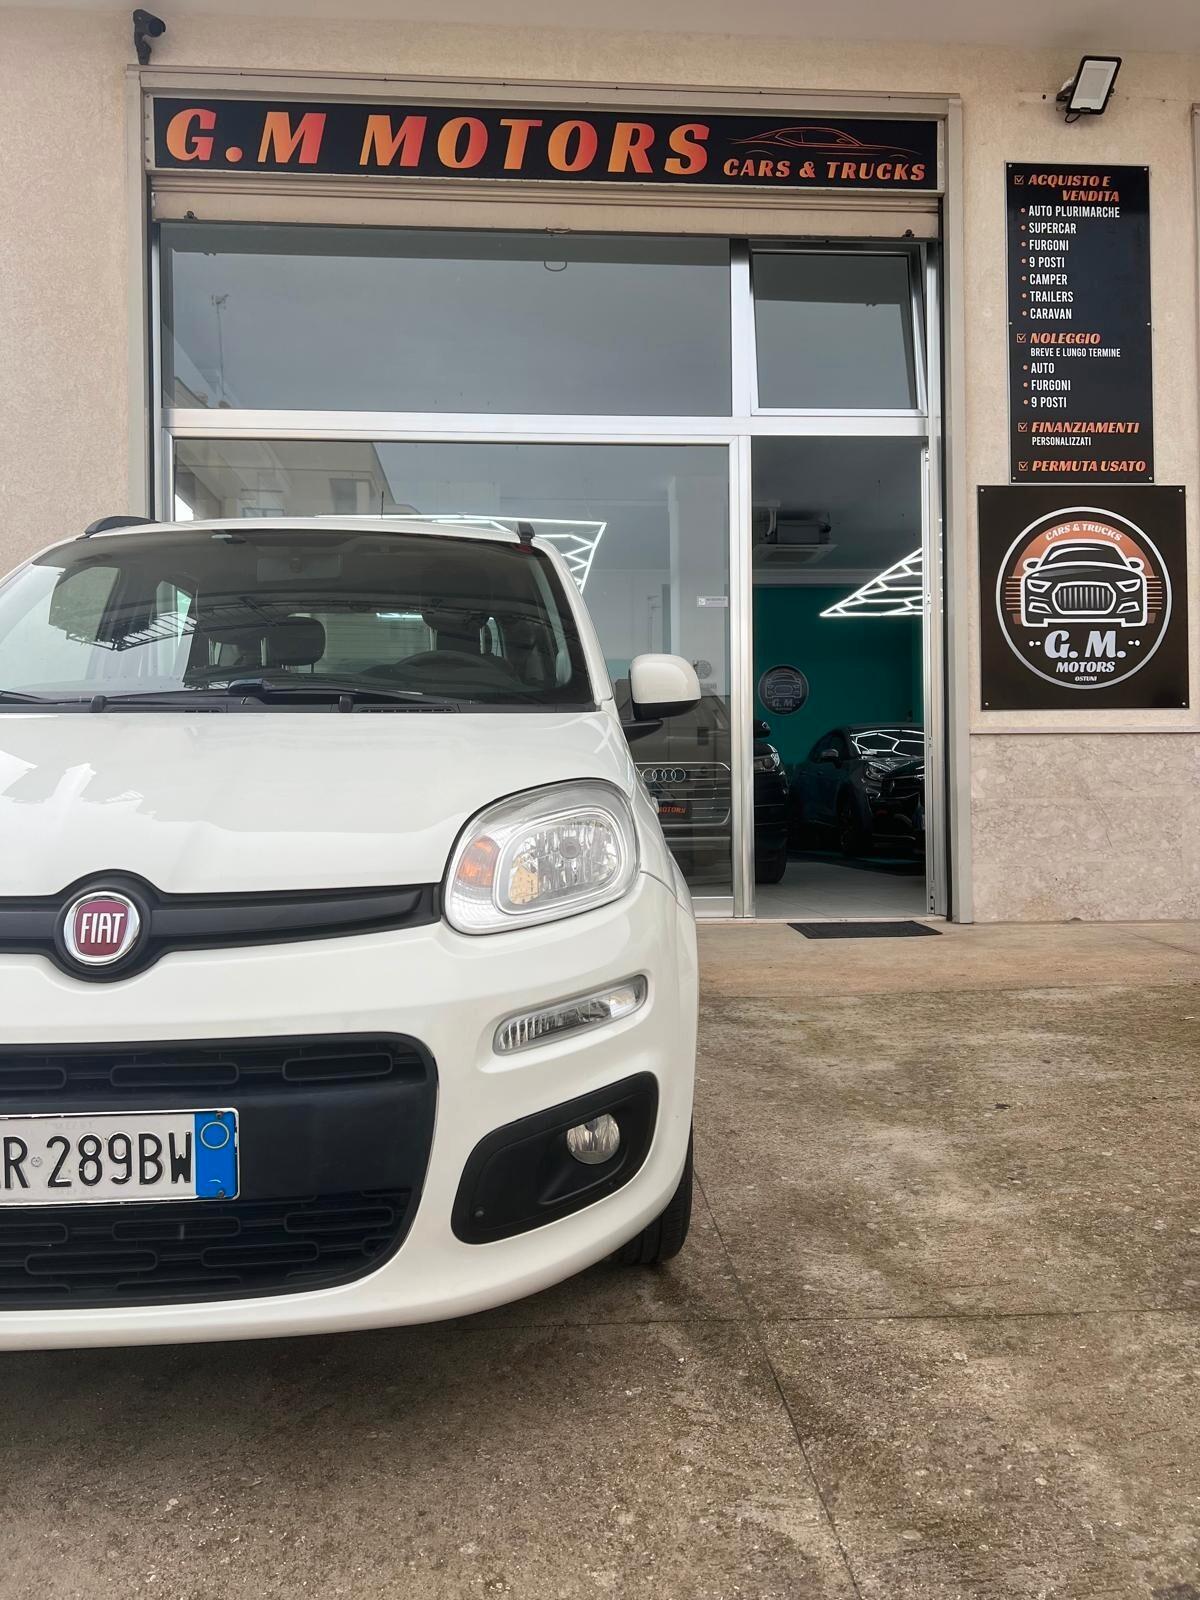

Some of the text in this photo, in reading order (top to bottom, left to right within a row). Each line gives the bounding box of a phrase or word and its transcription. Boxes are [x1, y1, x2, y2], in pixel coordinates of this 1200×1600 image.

[166, 108, 710, 175] G.M MOTORS
[723, 158, 926, 181] CARS & TRUCKS
[1028, 174, 1112, 187] ACQUISTO E
[1062, 190, 1120, 202] VENDITA
[1028, 205, 1120, 218] AUTO PLURIMARCHE
[1028, 222, 1077, 234] SUPERCAR
[1029, 239, 1069, 251] FURGONI
[1029, 256, 1065, 268] 9 POSTI
[1029, 273, 1068, 285] CAMPER
[1030, 290, 1074, 302] TRAILERS
[1030, 308, 1072, 320] CARAVAN
[1030, 332, 1101, 345] NOLEGGIO
[1030, 347, 1121, 358] BREVE E LUNGO TERMINE
[1030, 362, 1055, 374] AUTO
[1031, 379, 1071, 391] FURGONI
[1031, 396, 1067, 408] 9 POSTI
[1031, 421, 1140, 434] FINANZIAMENTI
[1031, 436, 1092, 446] PERSONALIZZATI
[1031, 460, 1147, 472] PERMUTA USATO
[1045, 523, 1122, 541] CARS & TRUCKS
[1056, 661, 1116, 673] MOTORS
[80, 913, 125, 943] FIAT
